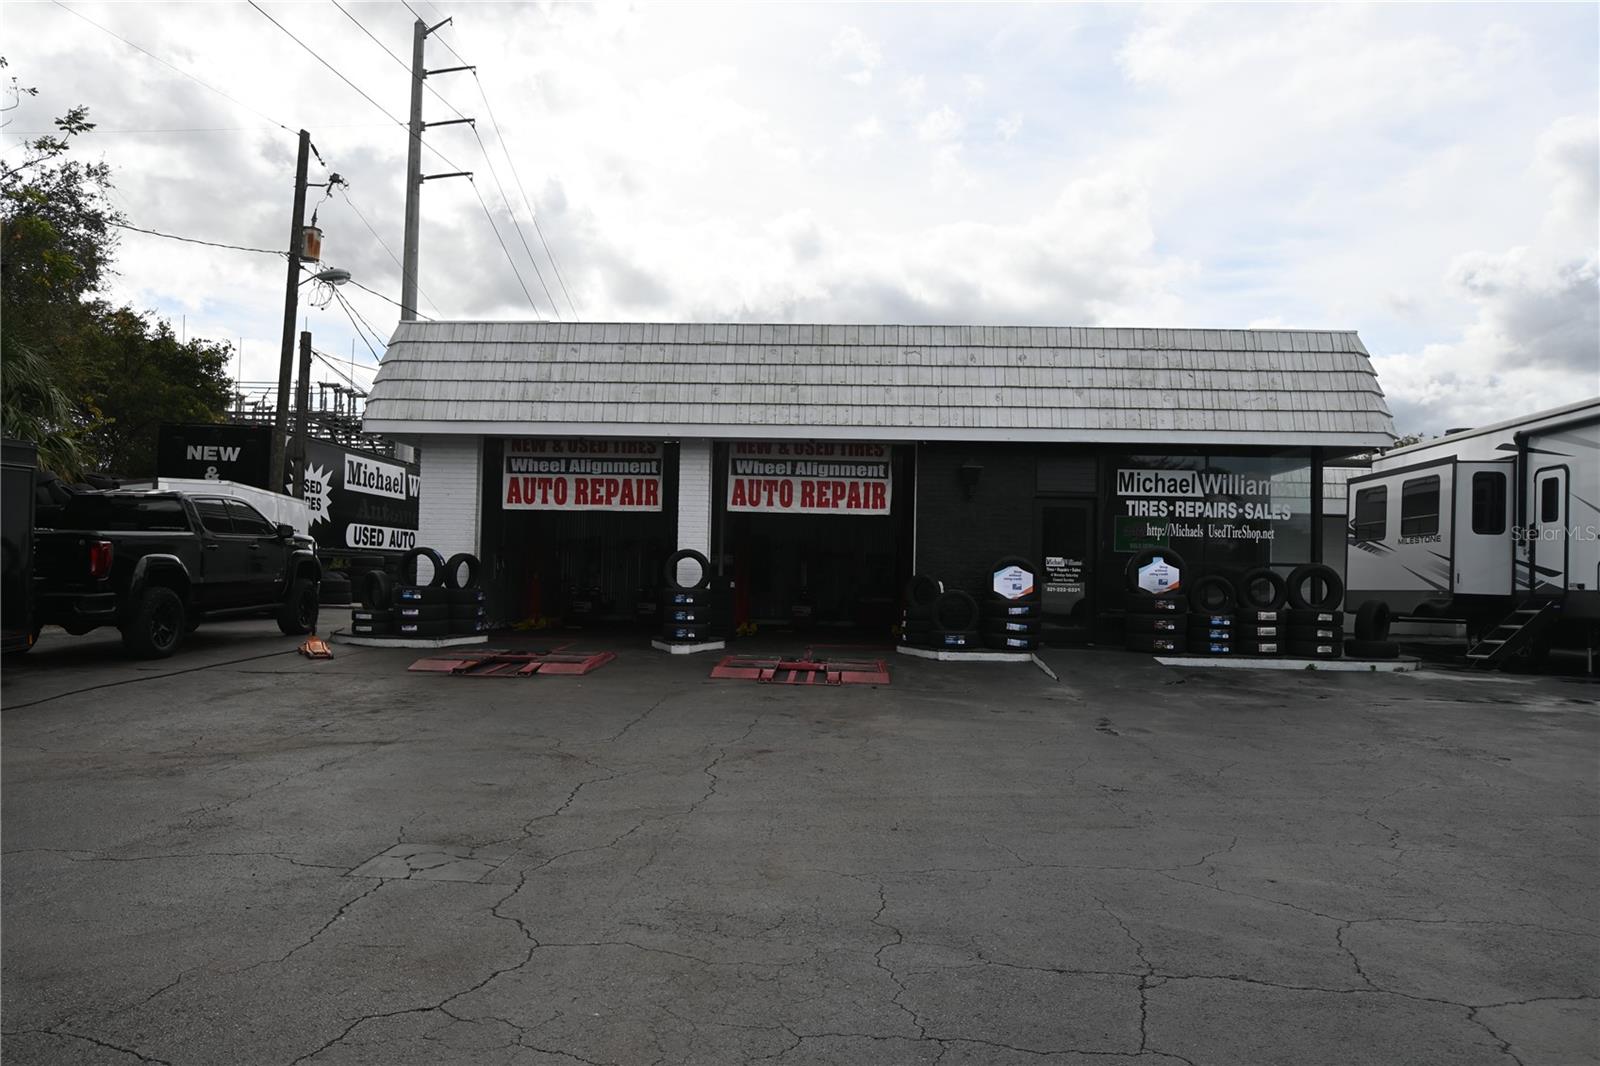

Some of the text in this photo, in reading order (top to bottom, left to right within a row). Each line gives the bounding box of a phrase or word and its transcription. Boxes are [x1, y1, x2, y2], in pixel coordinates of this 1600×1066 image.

[186, 445, 241, 462] NEW
[204, 465, 220, 480] &
[511, 458, 658, 475] Wheel Alignment
[736, 460, 886, 478] Wheel Alignment
[303, 479, 322, 494] SED
[347, 460, 404, 494] Michael
[1118, 472, 1272, 496] Michael William
[507, 477, 659, 506] AUTO REPAIR
[732, 479, 887, 509] AUTO REPAIR
[354, 526, 416, 548] USED AUTO
[1146, 522, 1204, 541] http://Michaels
[1208, 524, 1275, 544] UsedTireShop.net
[1397, 535, 1442, 545] MILESTONE
